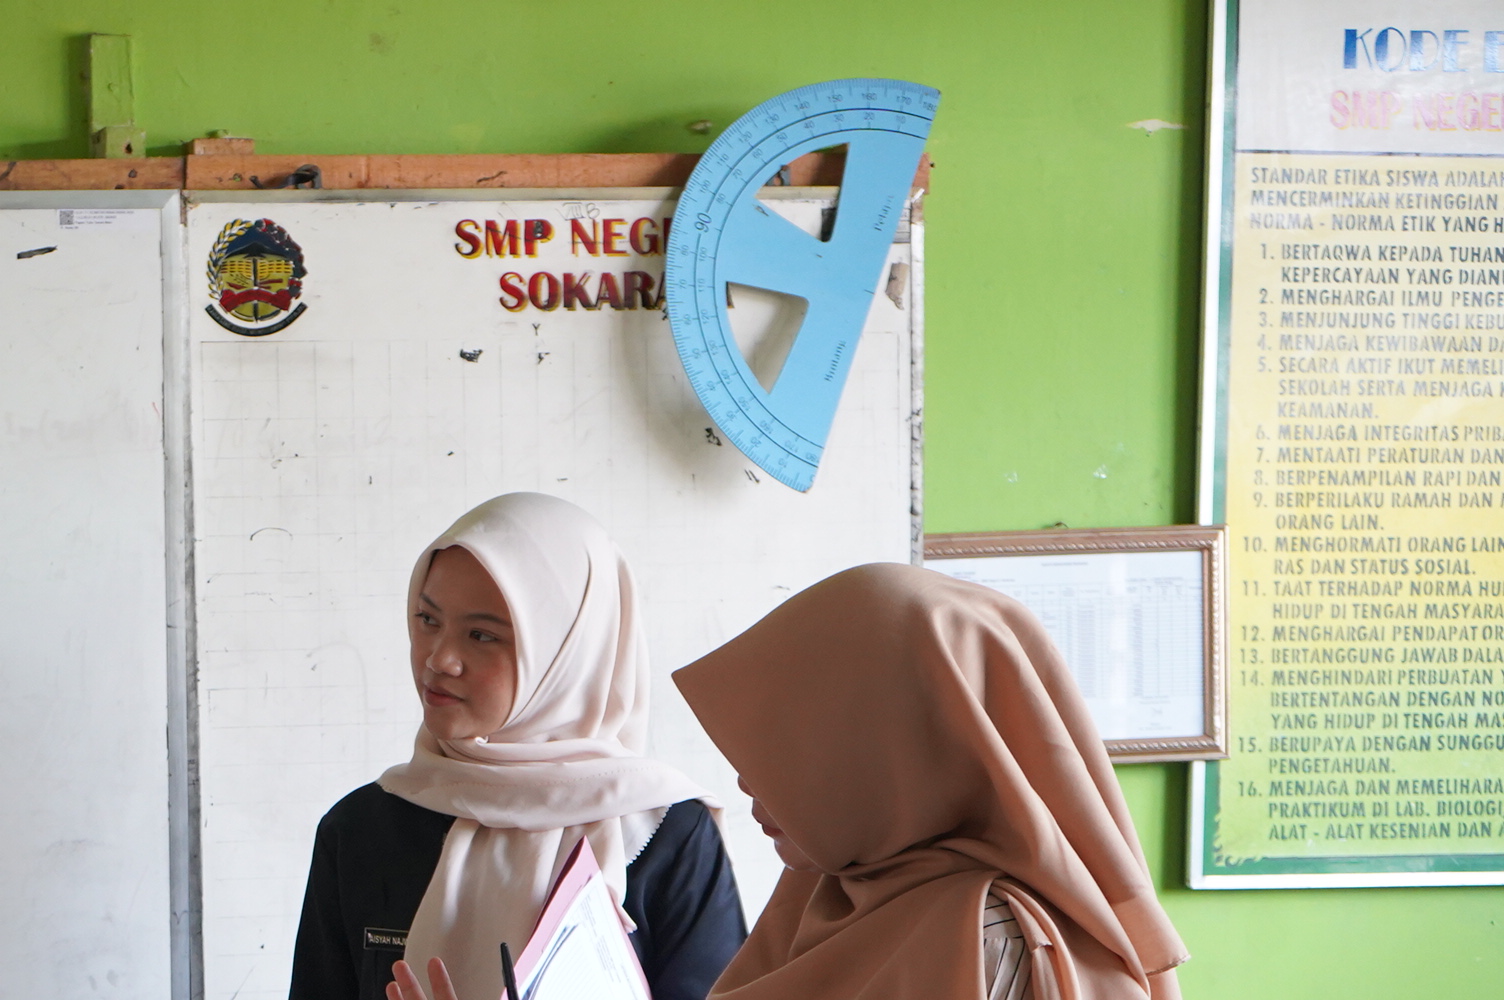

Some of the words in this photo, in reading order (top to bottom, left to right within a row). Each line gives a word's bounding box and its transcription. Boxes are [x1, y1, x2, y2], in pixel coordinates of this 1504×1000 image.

[1343, 28, 1471, 74] KODE
[1329, 90, 1402, 131] SMP
[1413, 91, 1504, 132] NEGE
[1252, 167, 1327, 184] STANDAR
[1335, 169, 1380, 186] ETIKA
[1386, 170, 1438, 187] SISWA
[1251, 190, 1389, 208] MENCERMINKAN
[1396, 194, 1498, 210] KETINGGIAN
[694, 212, 712, 233] 90
[1250, 213, 1314, 230] NORMA
[1332, 215, 1395, 231] NORMA
[1402, 216, 1435, 232] ETIK
[1443, 217, 1488, 232] YANG
[454, 218, 556, 258] SMP
[1261, 243, 1274, 259] 1.
[1282, 244, 1371, 260] BERTAQWA
[1379, 246, 1443, 262] KEPADA
[1282, 267, 1399, 283] KEPERCAYAAN
[1407, 269, 1452, 284] YANG
[1459, 269, 1504, 285] DIAN
[1260, 288, 1272, 304] 2.
[1282, 289, 1394, 305] MENGHARGAI
[1402, 291, 1442, 307] ILMU
[1259, 311, 1273, 327] 3.
[1280, 312, 1395, 328] MENJUNJUNG
[1402, 313, 1459, 330] TINGGI
[1257, 334, 1271, 350] 4.
[1279, 334, 1359, 351] MENJAGA
[1366, 336, 1482, 352] KEWIBAWAAN
[1258, 356, 1272, 372] 5.
[1279, 357, 1339, 373] SECARA
[1346, 358, 1391, 374] AKTIF
[1398, 358, 1435, 375] IKUT
[1279, 379, 1350, 396] SEKOLAH
[1358, 380, 1405, 396] SERTA
[1413, 381, 1493, 397] MENJAGA
[1278, 402, 1378, 418] KEAMANAN.
[1256, 425, 1270, 440] 6.
[1279, 425, 1358, 441] MENJAGA
[1365, 425, 1459, 441] INTEGRITAS
[1464, 426, 1504, 441] PRIB
[1257, 447, 1269, 463] 7.
[1277, 447, 1360, 463] MENTAATI
[1368, 448, 1464, 463] PERATURAN
[1471, 449, 1504, 464] DAN
[1254, 469, 1268, 486] 8.
[1277, 470, 1416, 486] BERPENAMPILAN
[1423, 471, 1461, 486] RAPI
[1467, 471, 1500, 486] DAN
[1253, 492, 1267, 507] 9.
[1276, 492, 1384, 508] BERPERILAKU
[1392, 493, 1451, 508] RAMAH
[1459, 492, 1492, 508] DAN
[1276, 514, 1334, 530] ORANG
[1342, 515, 1383, 530] LAIN.
[1244, 536, 1267, 552] 10.
[1275, 537, 1400, 552] MENGHORMATI
[1408, 537, 1466, 552] ORANG
[1274, 559, 1304, 575] RAS
[1311, 559, 1345, 574] DAN
[1351, 559, 1409, 575] STATUS
[1415, 559, 1475, 575] SOSIAL.
[1243, 580, 1266, 596] 11.
[1274, 581, 1312, 596] TAAT
[1319, 581, 1403, 596] TERHADAP
[1410, 581, 1472, 596] NORMA
[1273, 604, 1323, 619] HIDUP
[1331, 604, 1346, 619] DI
[1353, 604, 1417, 619] TENGAH
[1242, 625, 1264, 642] 12.
[1273, 626, 1384, 641] MENGHARGAI
[1393, 626, 1479, 641] PENDAPAT
[1241, 648, 1263, 664] 13.
[1272, 648, 1394, 663] BERTANGGUNG
[1401, 648, 1458, 663] JAWAB
[1241, 670, 1264, 686] 14.
[1272, 670, 1392, 685] MENGHINDARI
[1398, 669, 1493, 685] PERBUATAN
[1271, 692, 1400, 707] BERTENTANGAN
[1407, 691, 1475, 706] DENGAN
[1271, 714, 1317, 729] YANG
[1324, 714, 1375, 729] HIDUP
[1382, 713, 1398, 729] DI
[1404, 713, 1467, 728] TENGAH
[1239, 737, 1262, 753] 15.
[1270, 737, 1356, 752] BERUPAYA
[1363, 736, 1431, 751] DENGAN
[1269, 758, 1395, 774] PENGETAHUAN.
[1238, 781, 1262, 797] 16.
[1269, 780, 1349, 796] MENJAGA
[1355, 780, 1389, 795] DAN
[1269, 802, 1366, 818] PRAKTIKUM
[1372, 801, 1388, 818] DI
[1396, 801, 1430, 817] LAB.
[1269, 824, 1307, 841] ALAT
[1325, 824, 1364, 839] ALAT
[1370, 823, 1450, 839] KESENIAN
[1458, 822, 1491, 837] DAN
